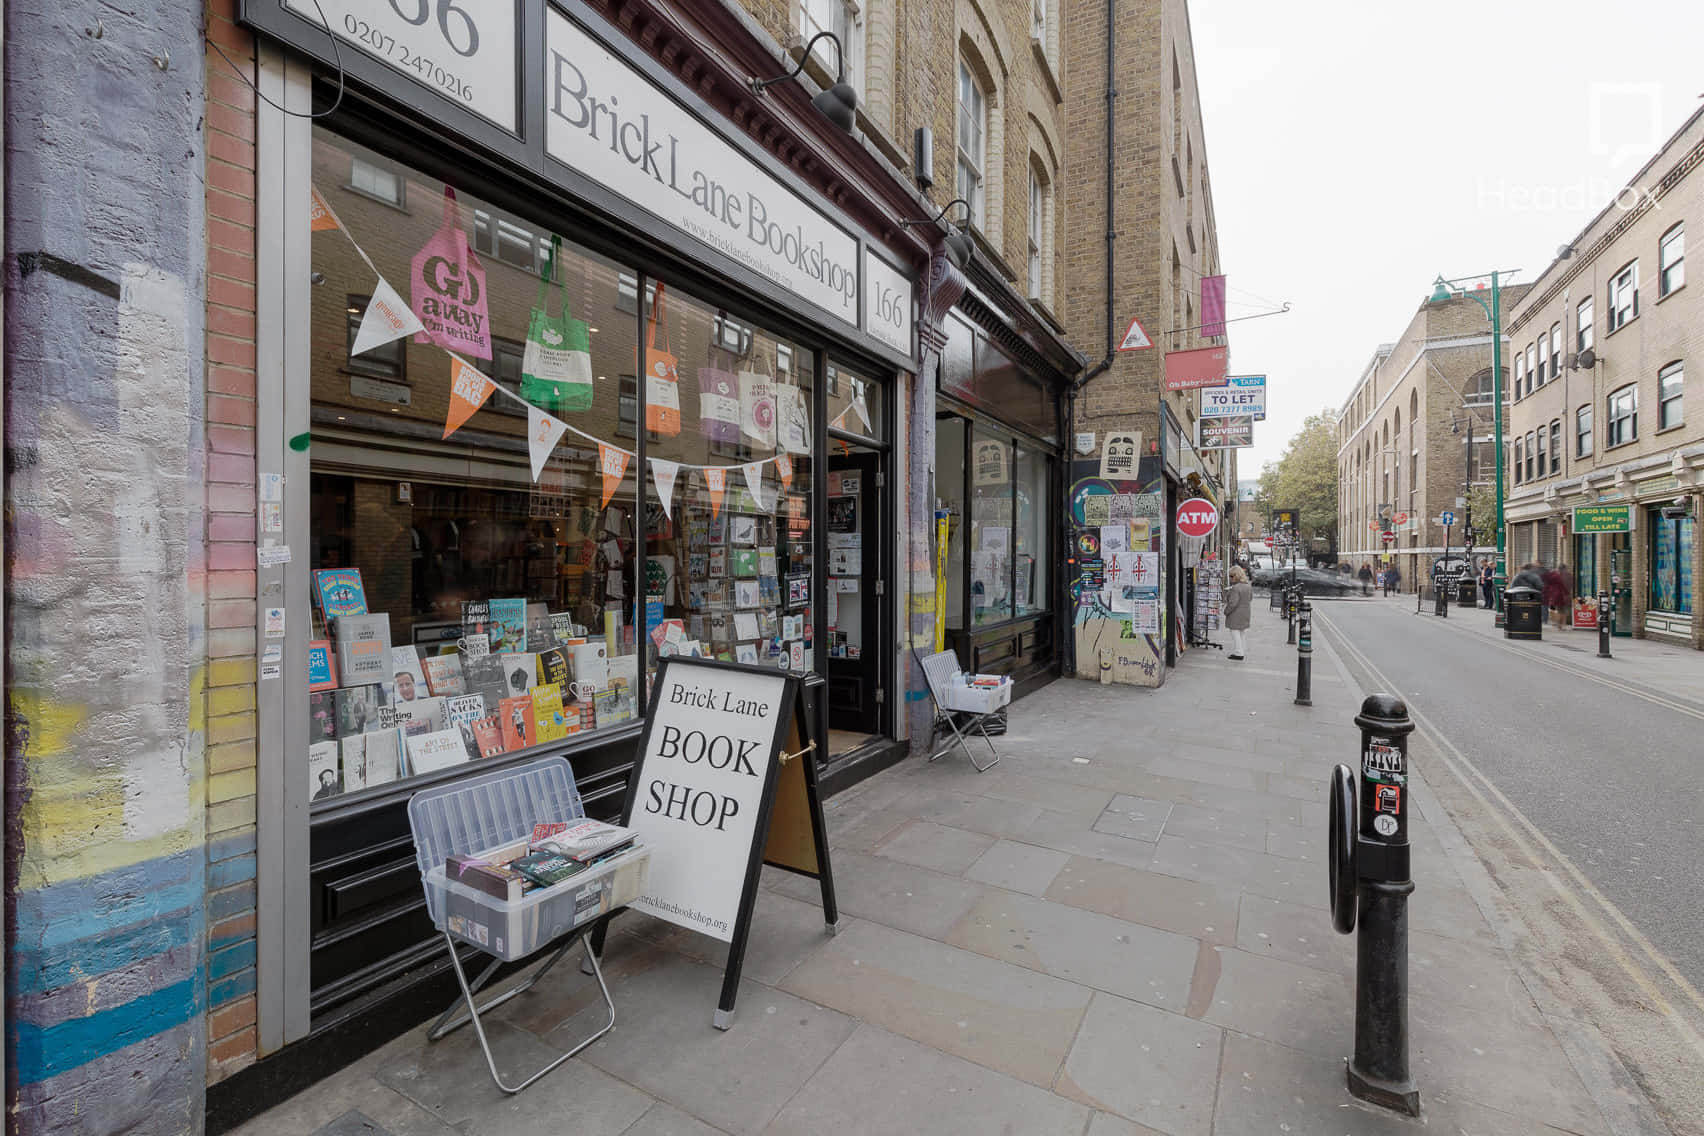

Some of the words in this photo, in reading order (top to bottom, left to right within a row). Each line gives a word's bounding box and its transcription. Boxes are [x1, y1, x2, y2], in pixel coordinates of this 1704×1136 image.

[344, 14, 396, 55] 0207
[400, 46, 474, 102] 2470216
[551, 47, 664, 184] Brick
[669, 134, 742, 230] Lane
[747, 192, 856, 308] Bookshop
[423, 297, 484, 334] away
[875, 281, 903, 328] 166
[1211, 395, 1228, 405] TO
[1232, 394, 1256, 404] LET
[1202, 427, 1249, 436] SOUVENIR
[1177, 512, 1217, 525] ATM
[379, 707, 397, 716] The
[670, 683, 717, 711] Brick
[722, 691, 769, 718] Lane
[656, 725, 763, 777] BOOK
[645, 780, 740, 832] SHOP
